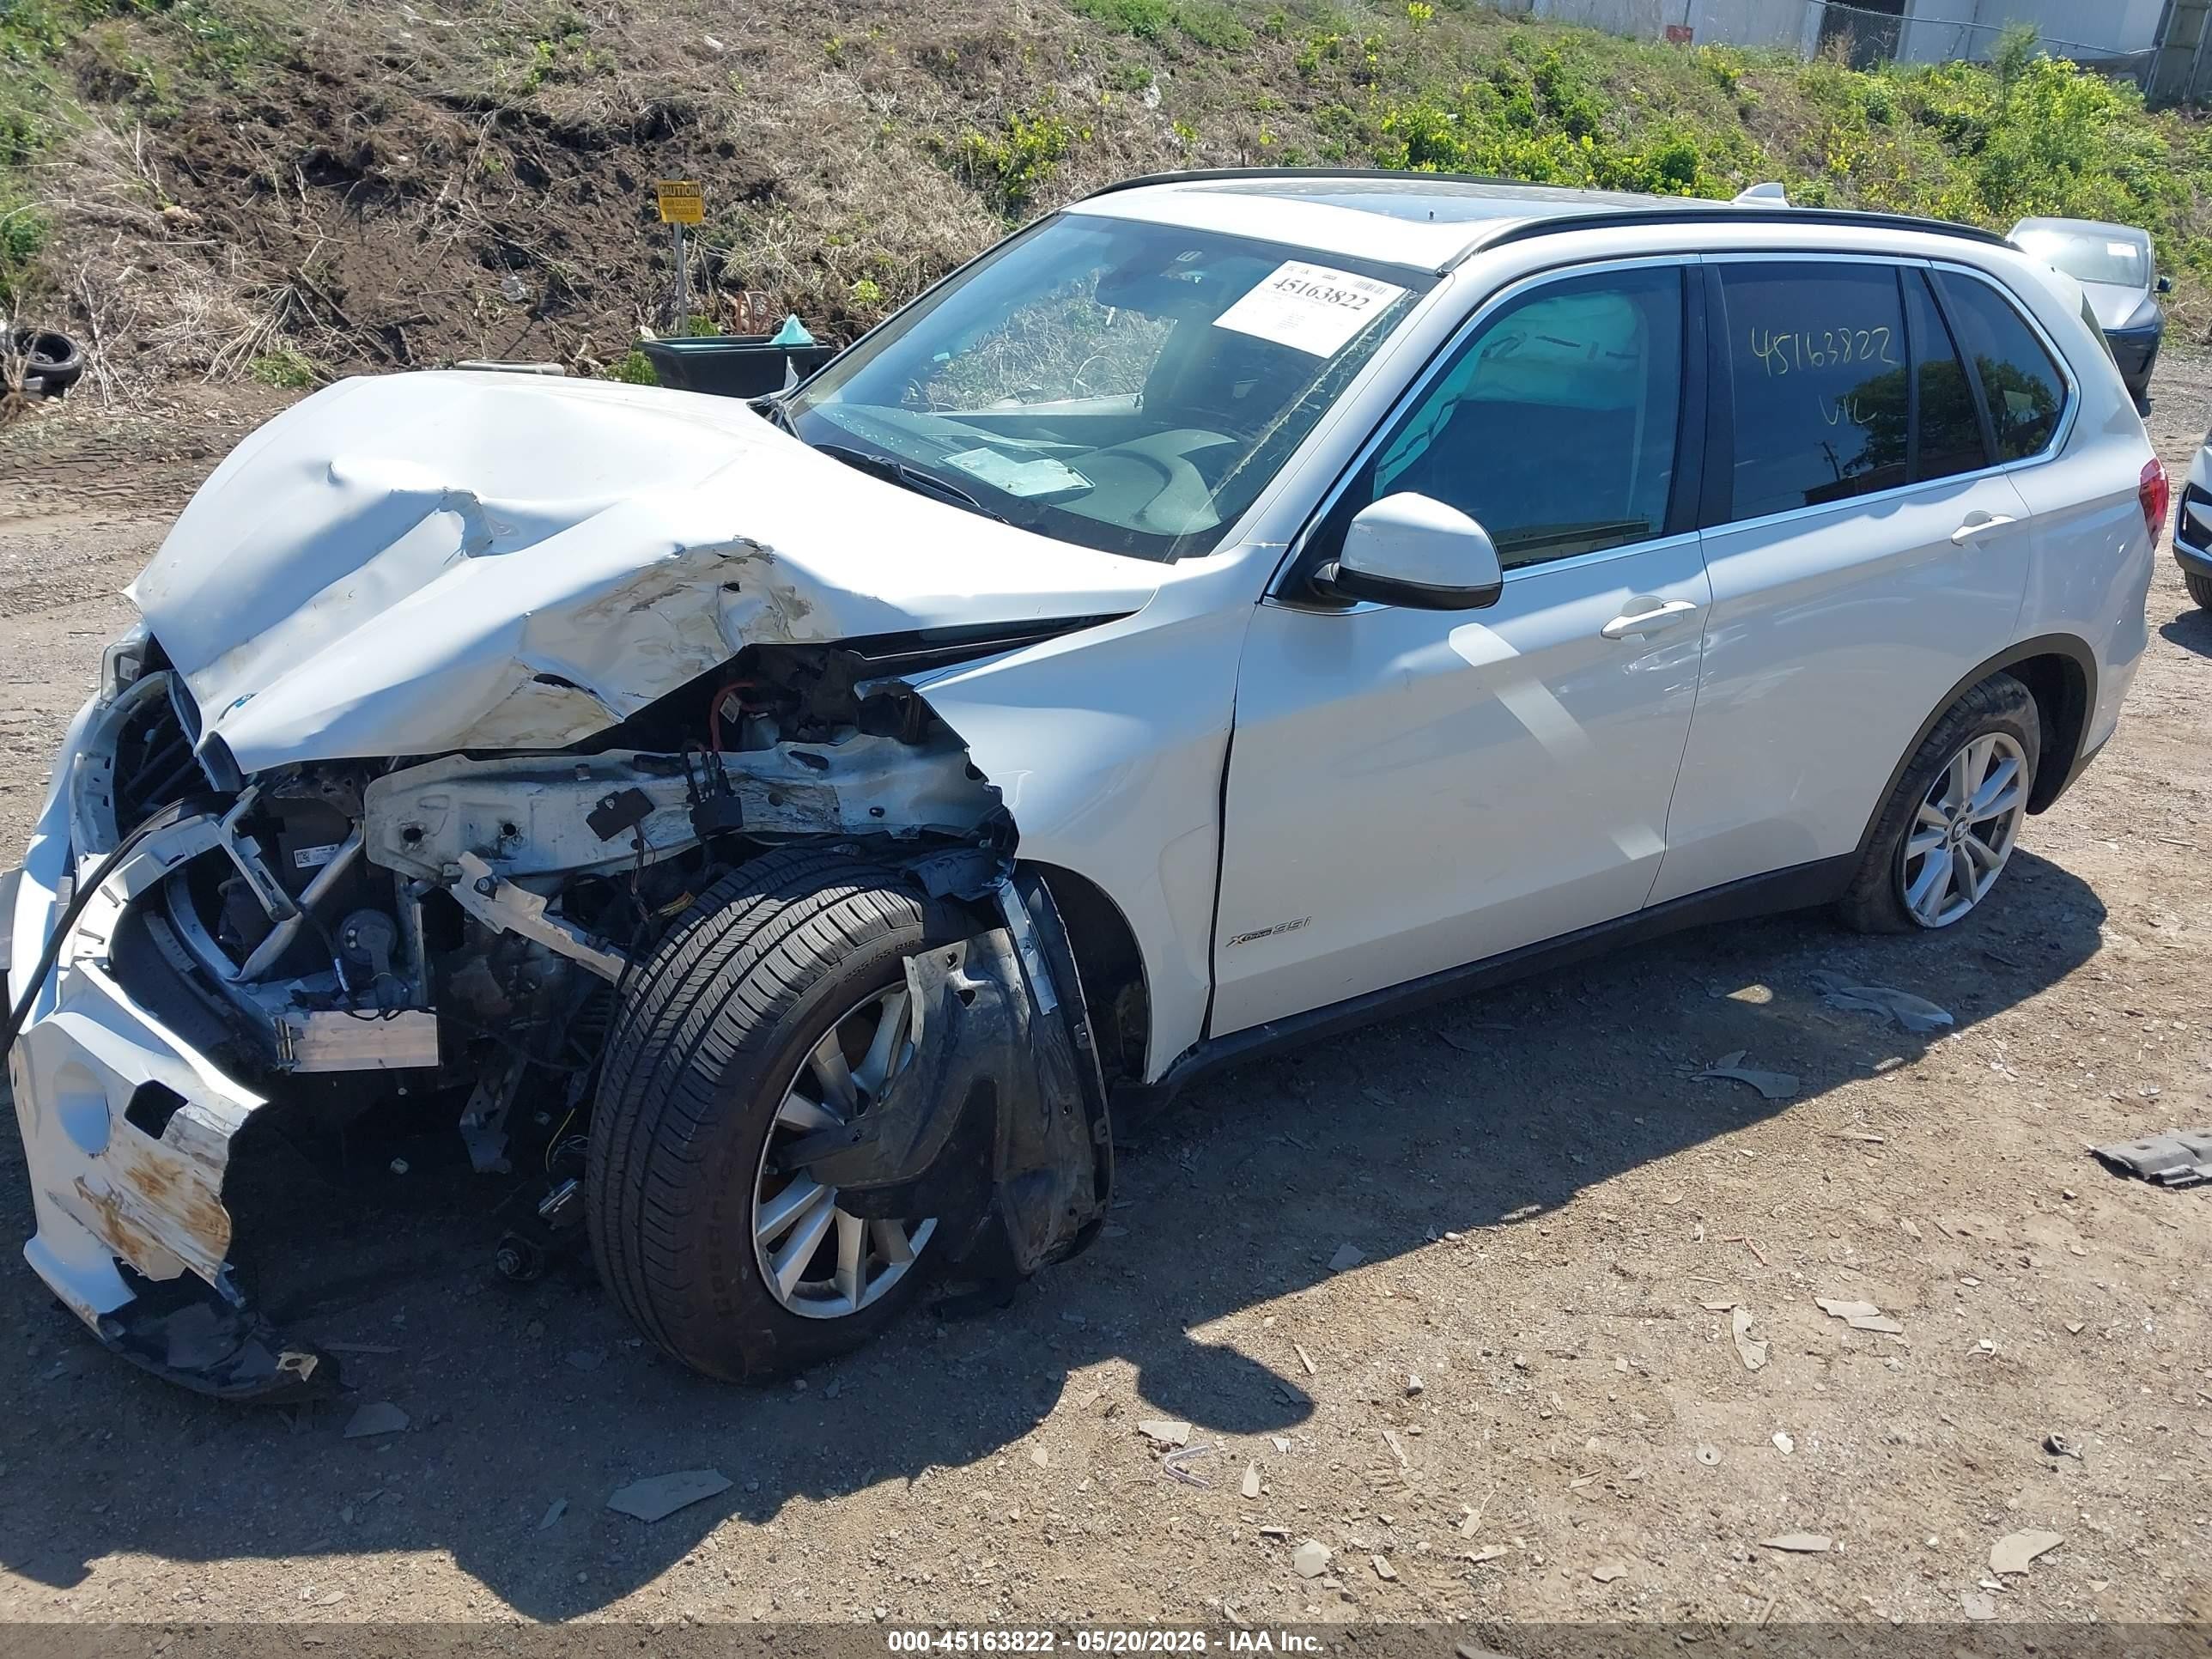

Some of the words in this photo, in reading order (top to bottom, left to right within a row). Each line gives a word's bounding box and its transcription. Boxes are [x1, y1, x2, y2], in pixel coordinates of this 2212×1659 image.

[659, 185, 699, 197] CAUTION
[1273, 277, 1370, 310] 45163822
[1751, 325, 1900, 377] 45163822
